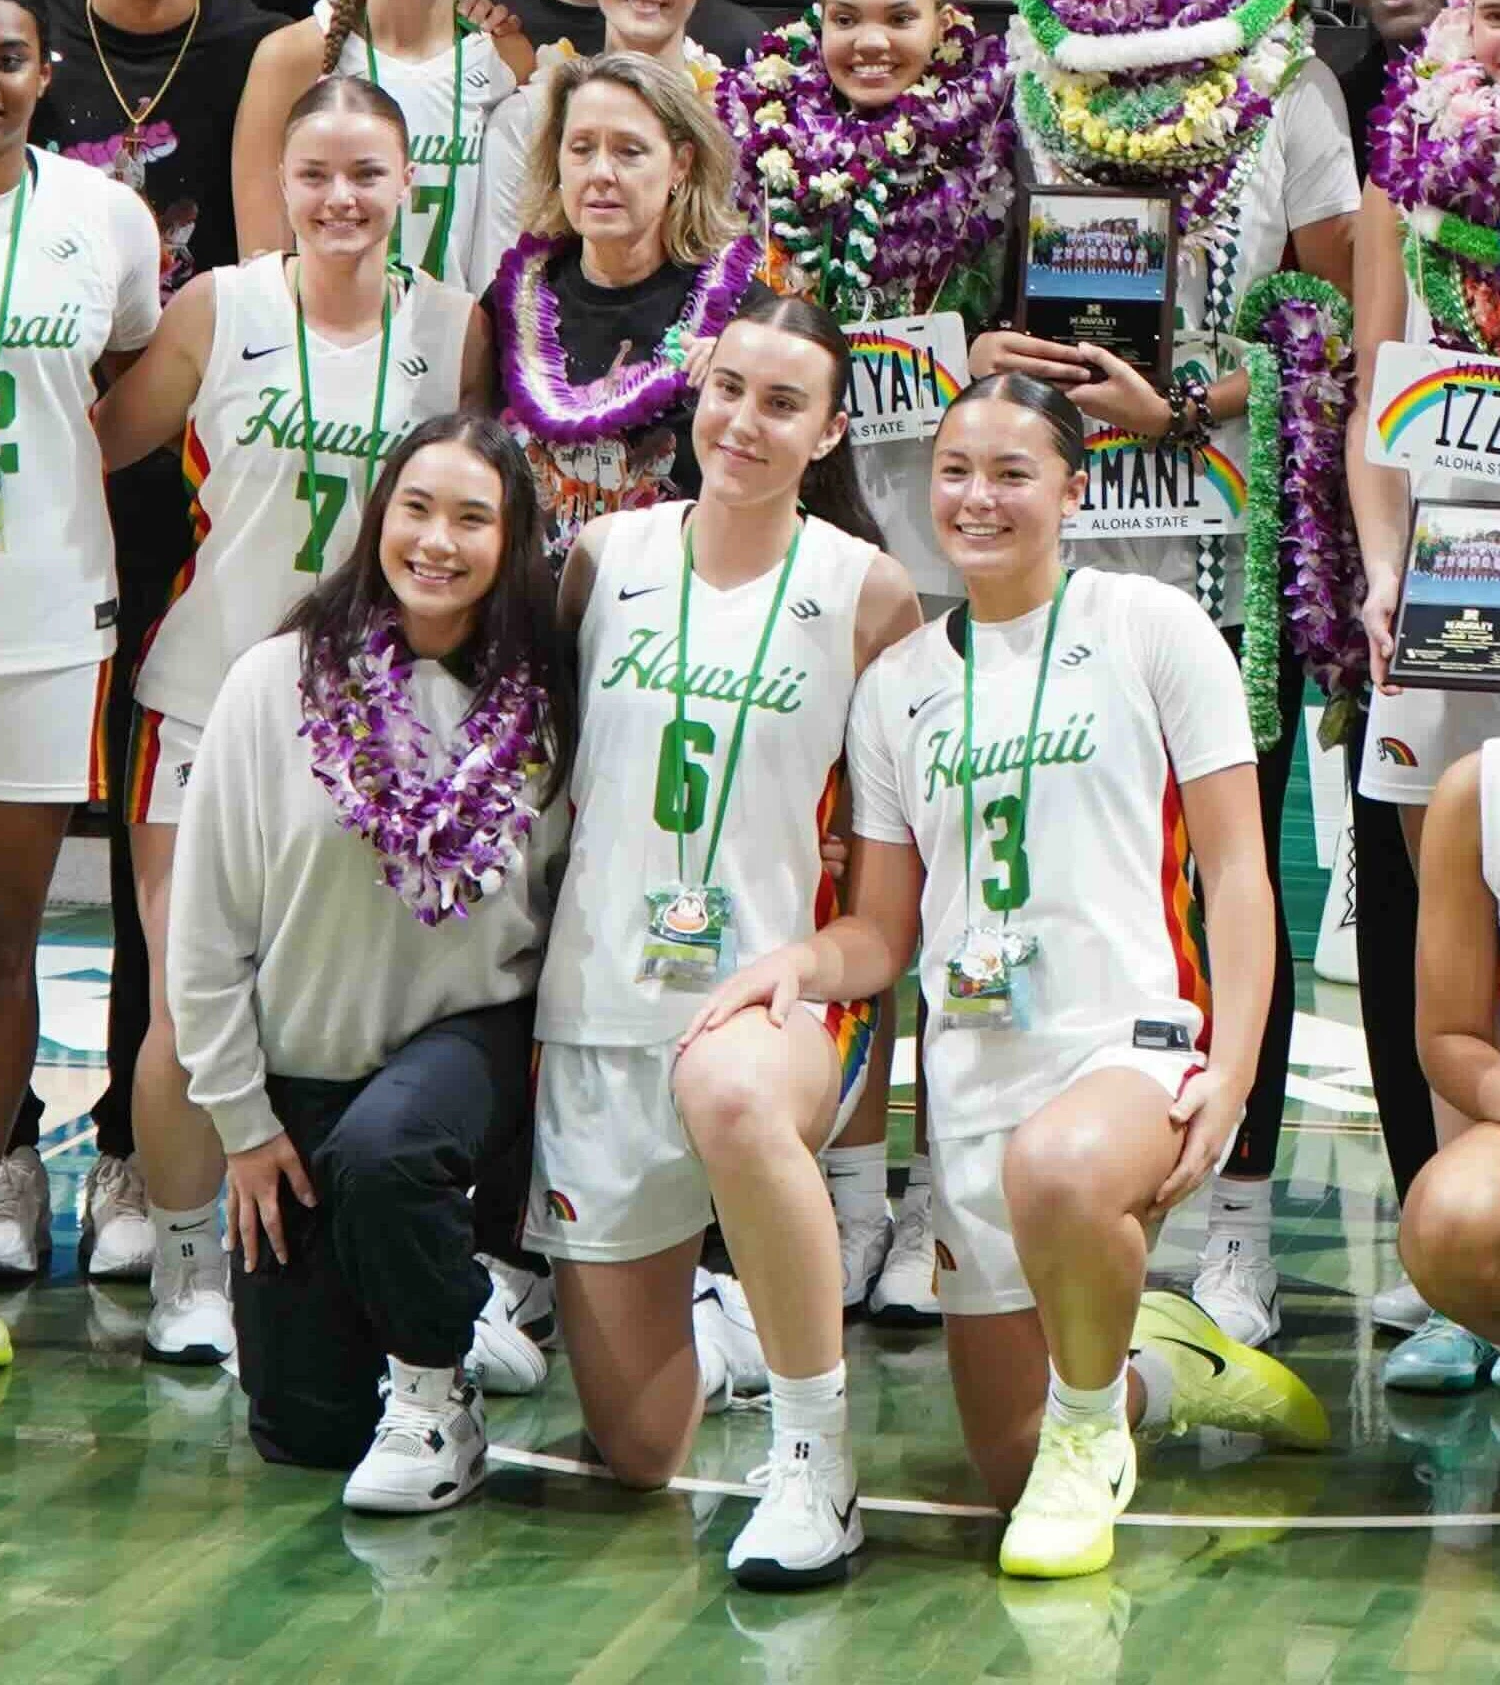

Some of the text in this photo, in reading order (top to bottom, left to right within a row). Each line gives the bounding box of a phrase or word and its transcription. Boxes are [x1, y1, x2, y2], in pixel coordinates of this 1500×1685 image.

[861, 419, 906, 438] STATE
[1435, 454, 1484, 474] ALOHA
[293, 471, 348, 573] 7
[1080, 448, 1200, 511] IMANI
[1091, 514, 1190, 532] ALOHA STATE
[602, 626, 802, 715] Hawaii
[652, 719, 718, 836] 6
[923, 711, 1098, 804] Hawaii
[981, 793, 1032, 914] 3
